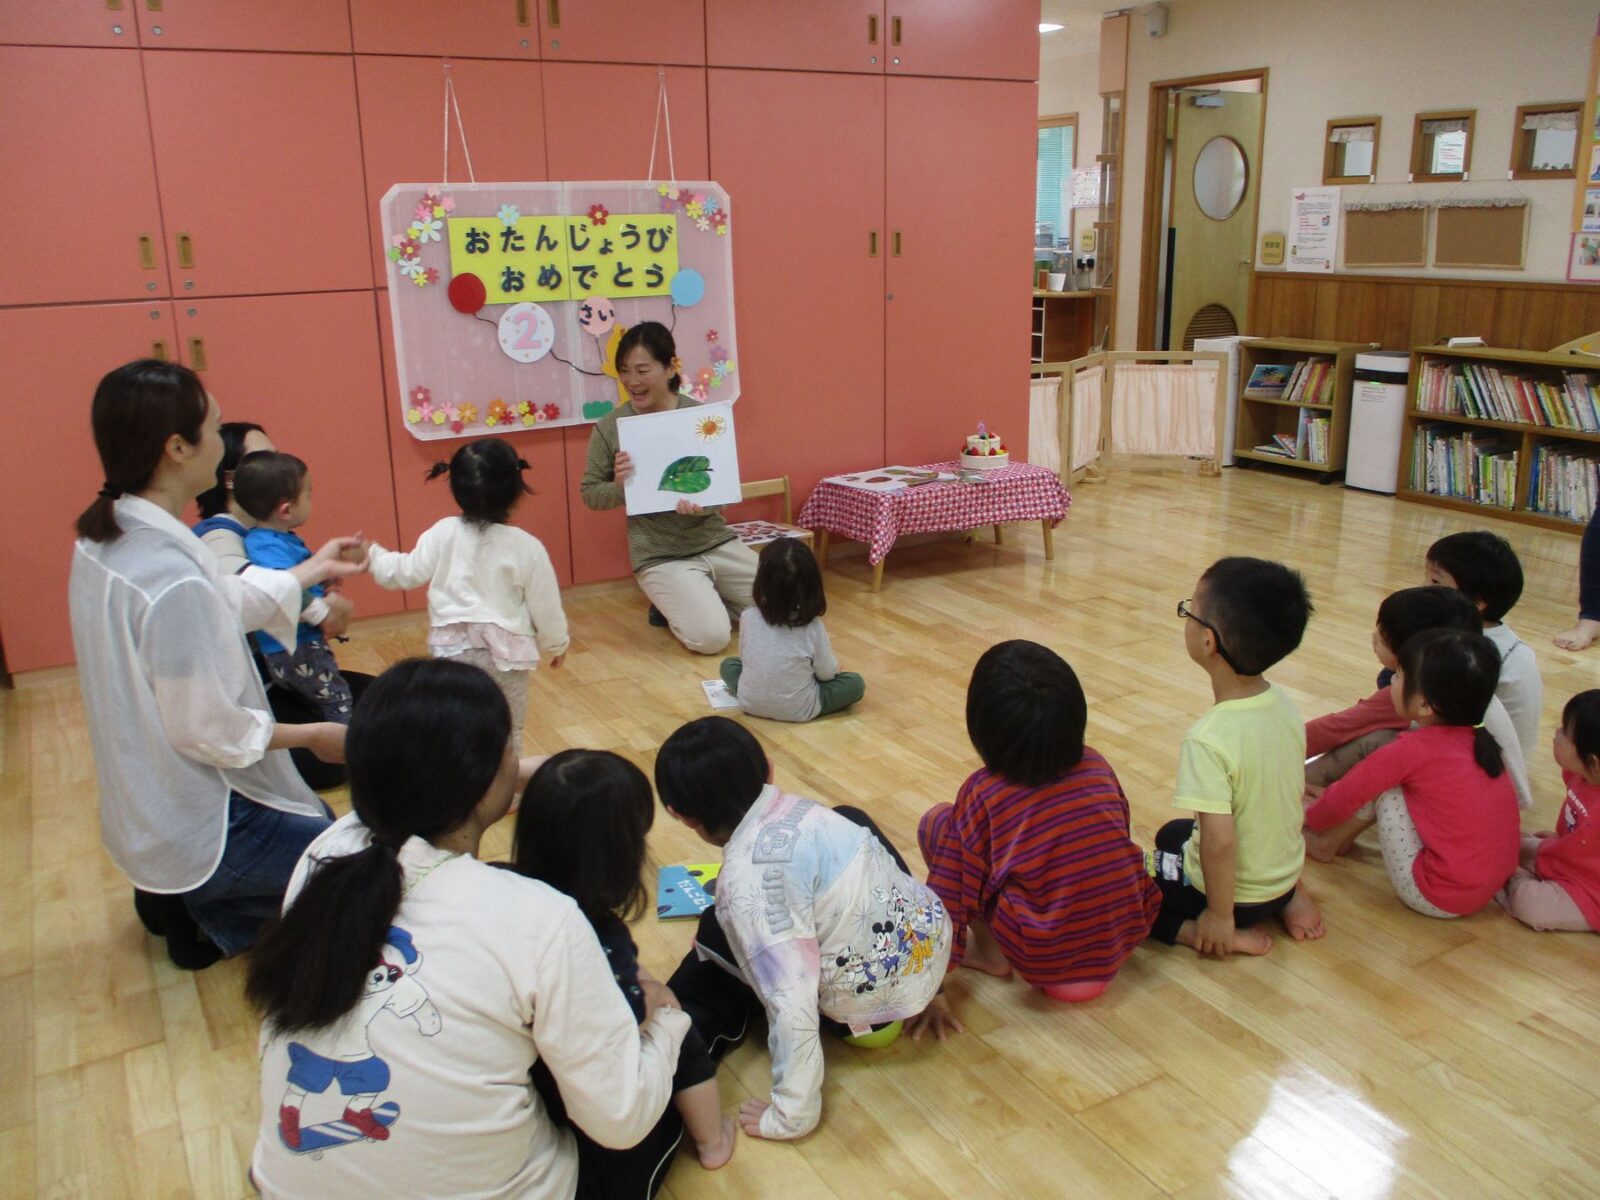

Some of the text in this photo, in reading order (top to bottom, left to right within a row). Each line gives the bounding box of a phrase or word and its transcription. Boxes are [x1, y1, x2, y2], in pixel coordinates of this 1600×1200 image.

[465, 223, 673, 254] おたんじょうび
[501, 262, 664, 292] おめでとう
[579, 304, 614, 325] さい
[512, 311, 542, 350] 2
